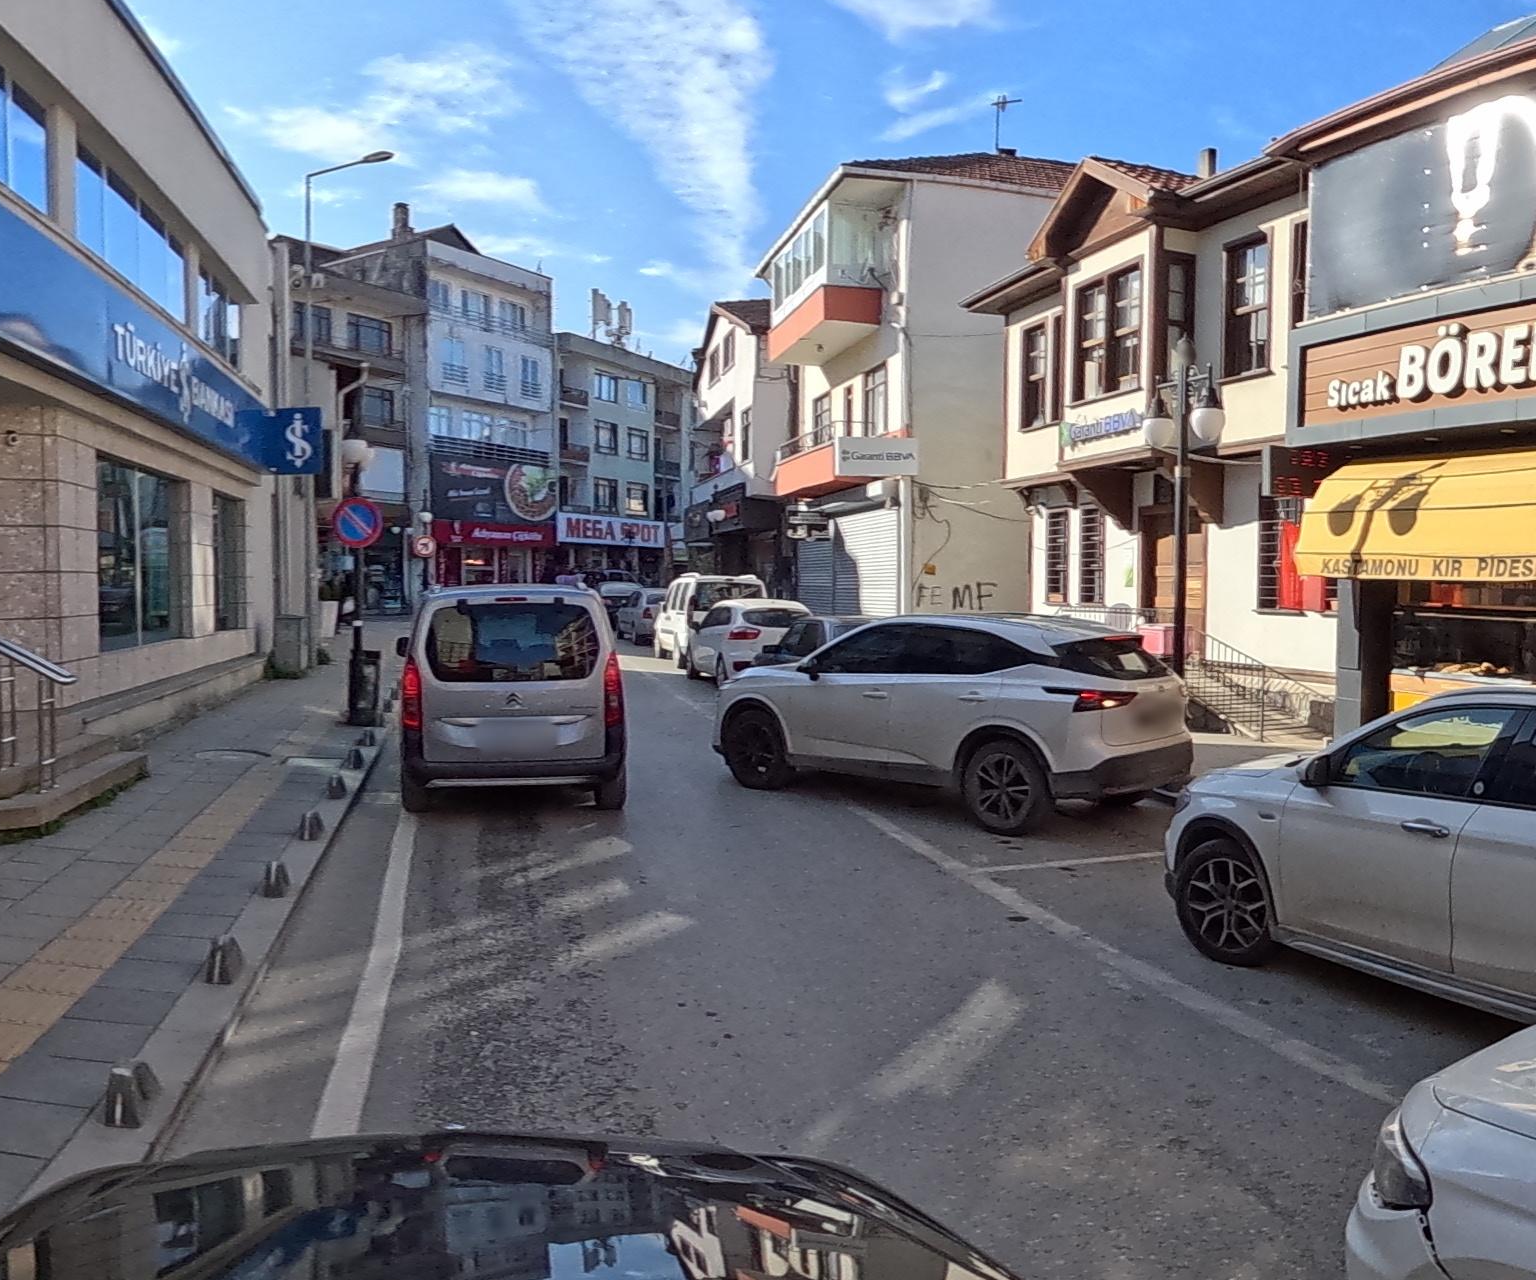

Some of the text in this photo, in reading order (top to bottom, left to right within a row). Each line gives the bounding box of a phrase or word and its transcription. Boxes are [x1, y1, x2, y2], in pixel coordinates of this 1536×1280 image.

[113, 322, 181, 394] TÜRKİYE
[1327, 370, 1393, 408] Sıcak
[566, 517, 616, 540] MEGA
[1321, 558, 1420, 578] KASTAMONU
[1431, 559, 1463, 578] KIR
